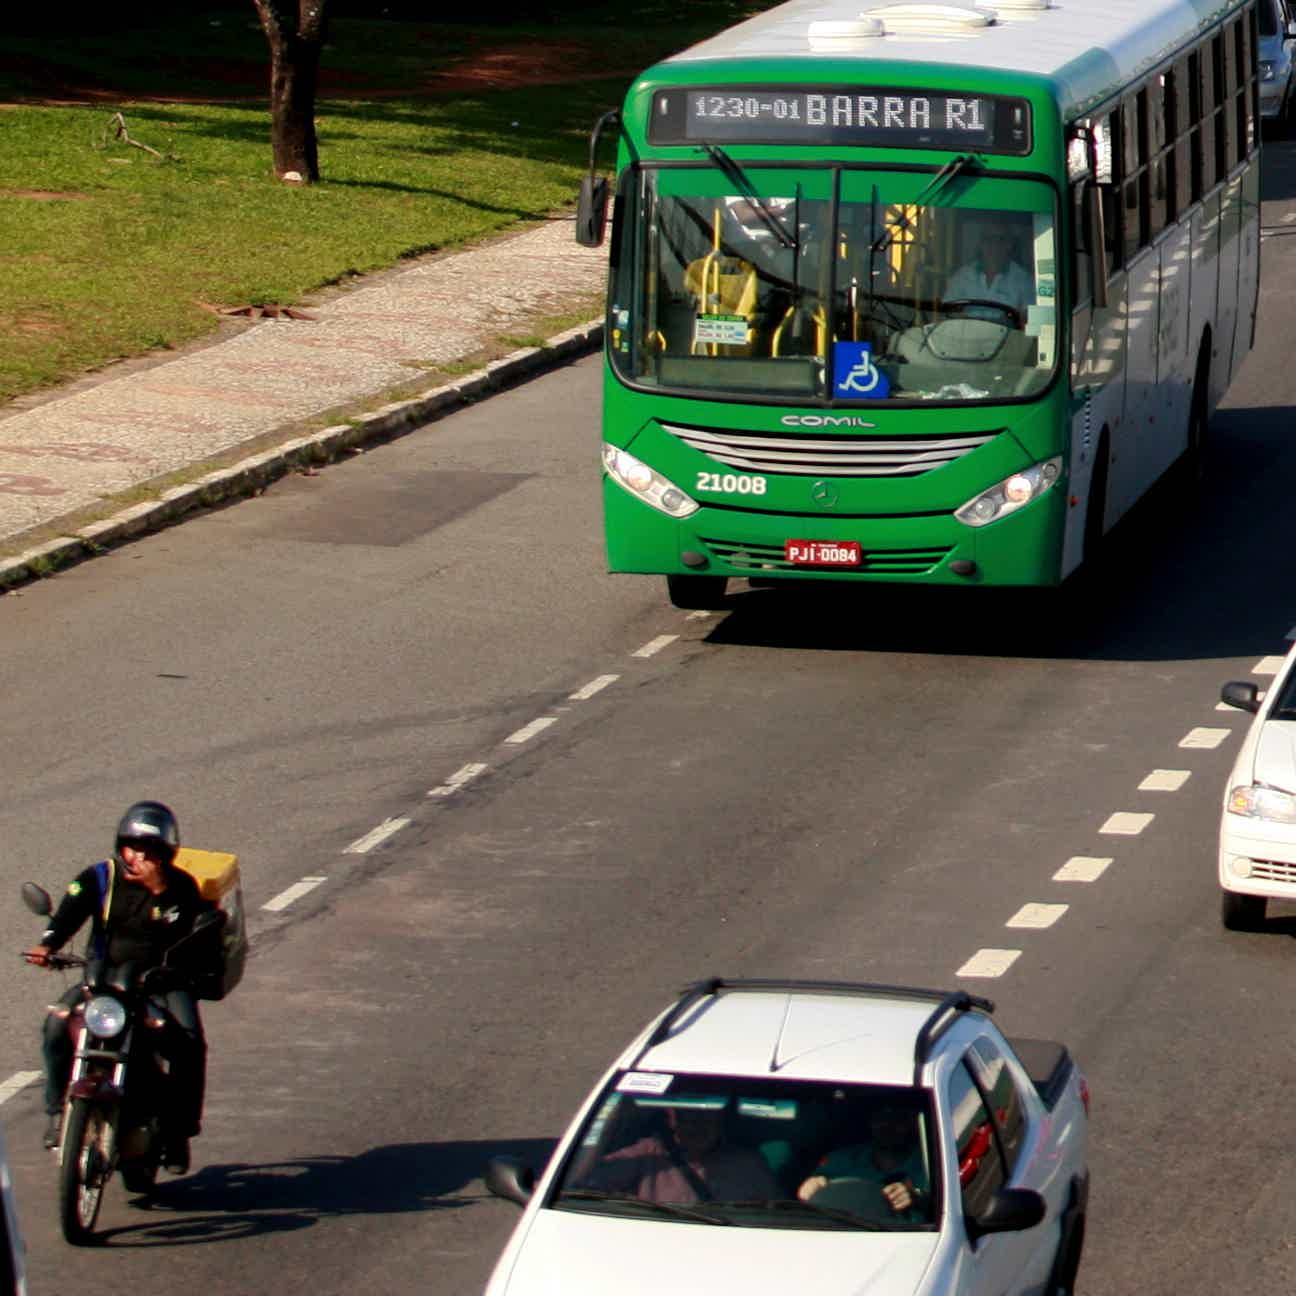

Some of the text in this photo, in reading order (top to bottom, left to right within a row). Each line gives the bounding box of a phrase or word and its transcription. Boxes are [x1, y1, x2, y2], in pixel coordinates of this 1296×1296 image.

[695, 96, 801, 119] 1230-01
[806, 94, 930, 128] BARRA
[781, 415, 876, 427] COMIL
[696, 472, 767, 494] 21008
